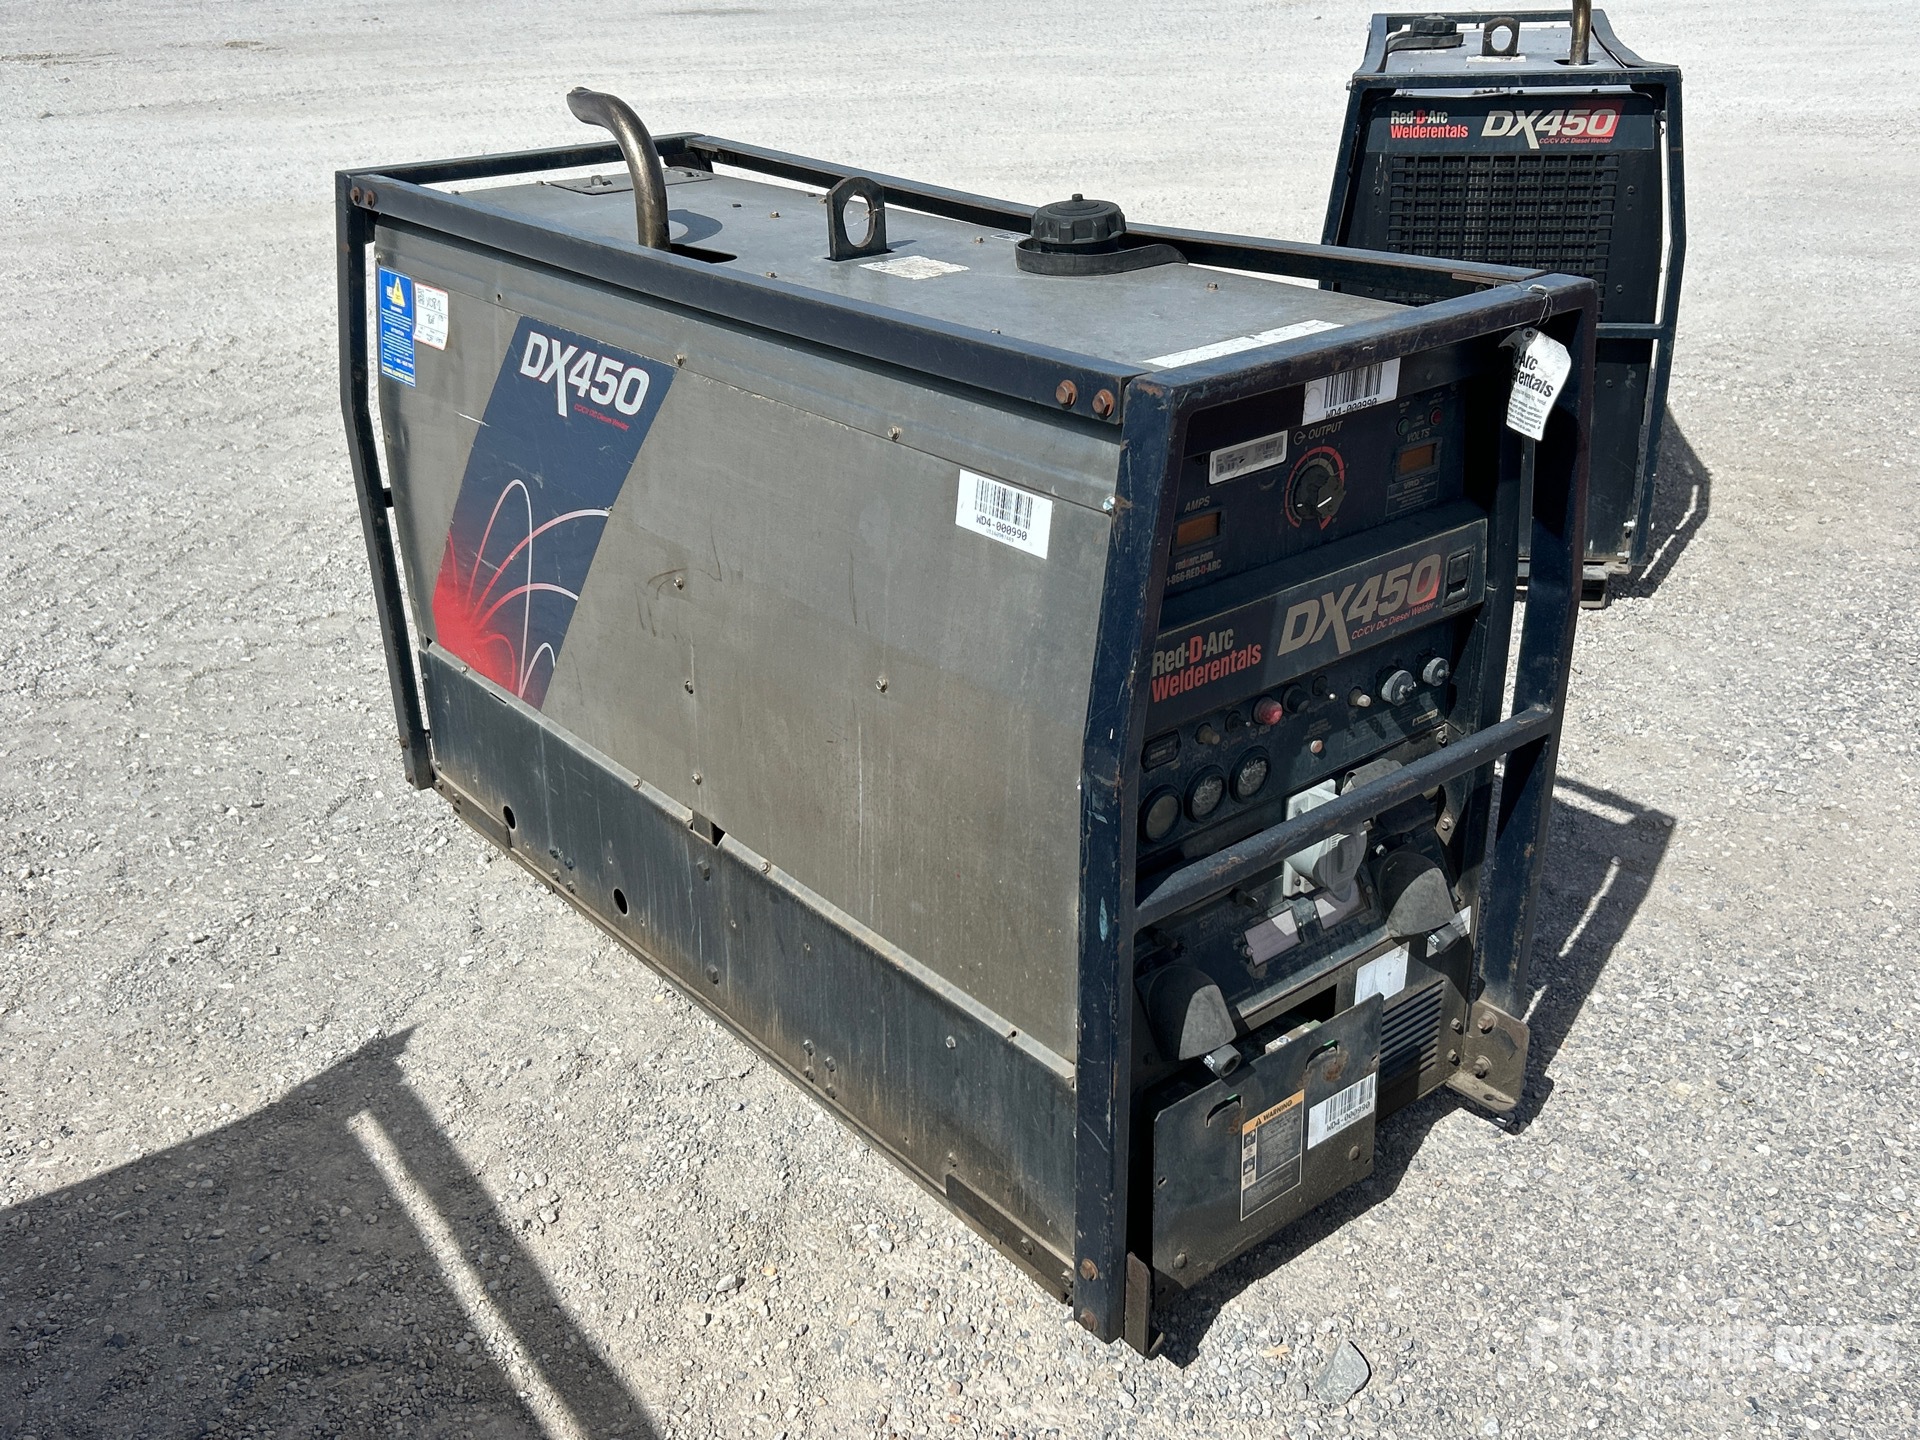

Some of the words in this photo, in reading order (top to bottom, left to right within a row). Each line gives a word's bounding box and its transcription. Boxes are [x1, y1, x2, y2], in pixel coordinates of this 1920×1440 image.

[1390, 124, 1469, 139] Welderentals
[1481, 108, 1617, 150] DX450
[519, 331, 650, 418] DX450
[1308, 421, 1344, 440] OUTPUT
[1407, 428, 1431, 443] VOLTS
[1184, 495, 1211, 513] AMPS
[975, 514, 1028, 541] WD4-000990
[1277, 553, 1442, 656] DX450
[1376, 618, 1388, 632] DC
[1388, 611, 1411, 627] Diesel
[1411, 602, 1435, 617] Welder
[1151, 643, 1263, 704] Welderentals
[1263, 1099, 1293, 1121] WARNING
